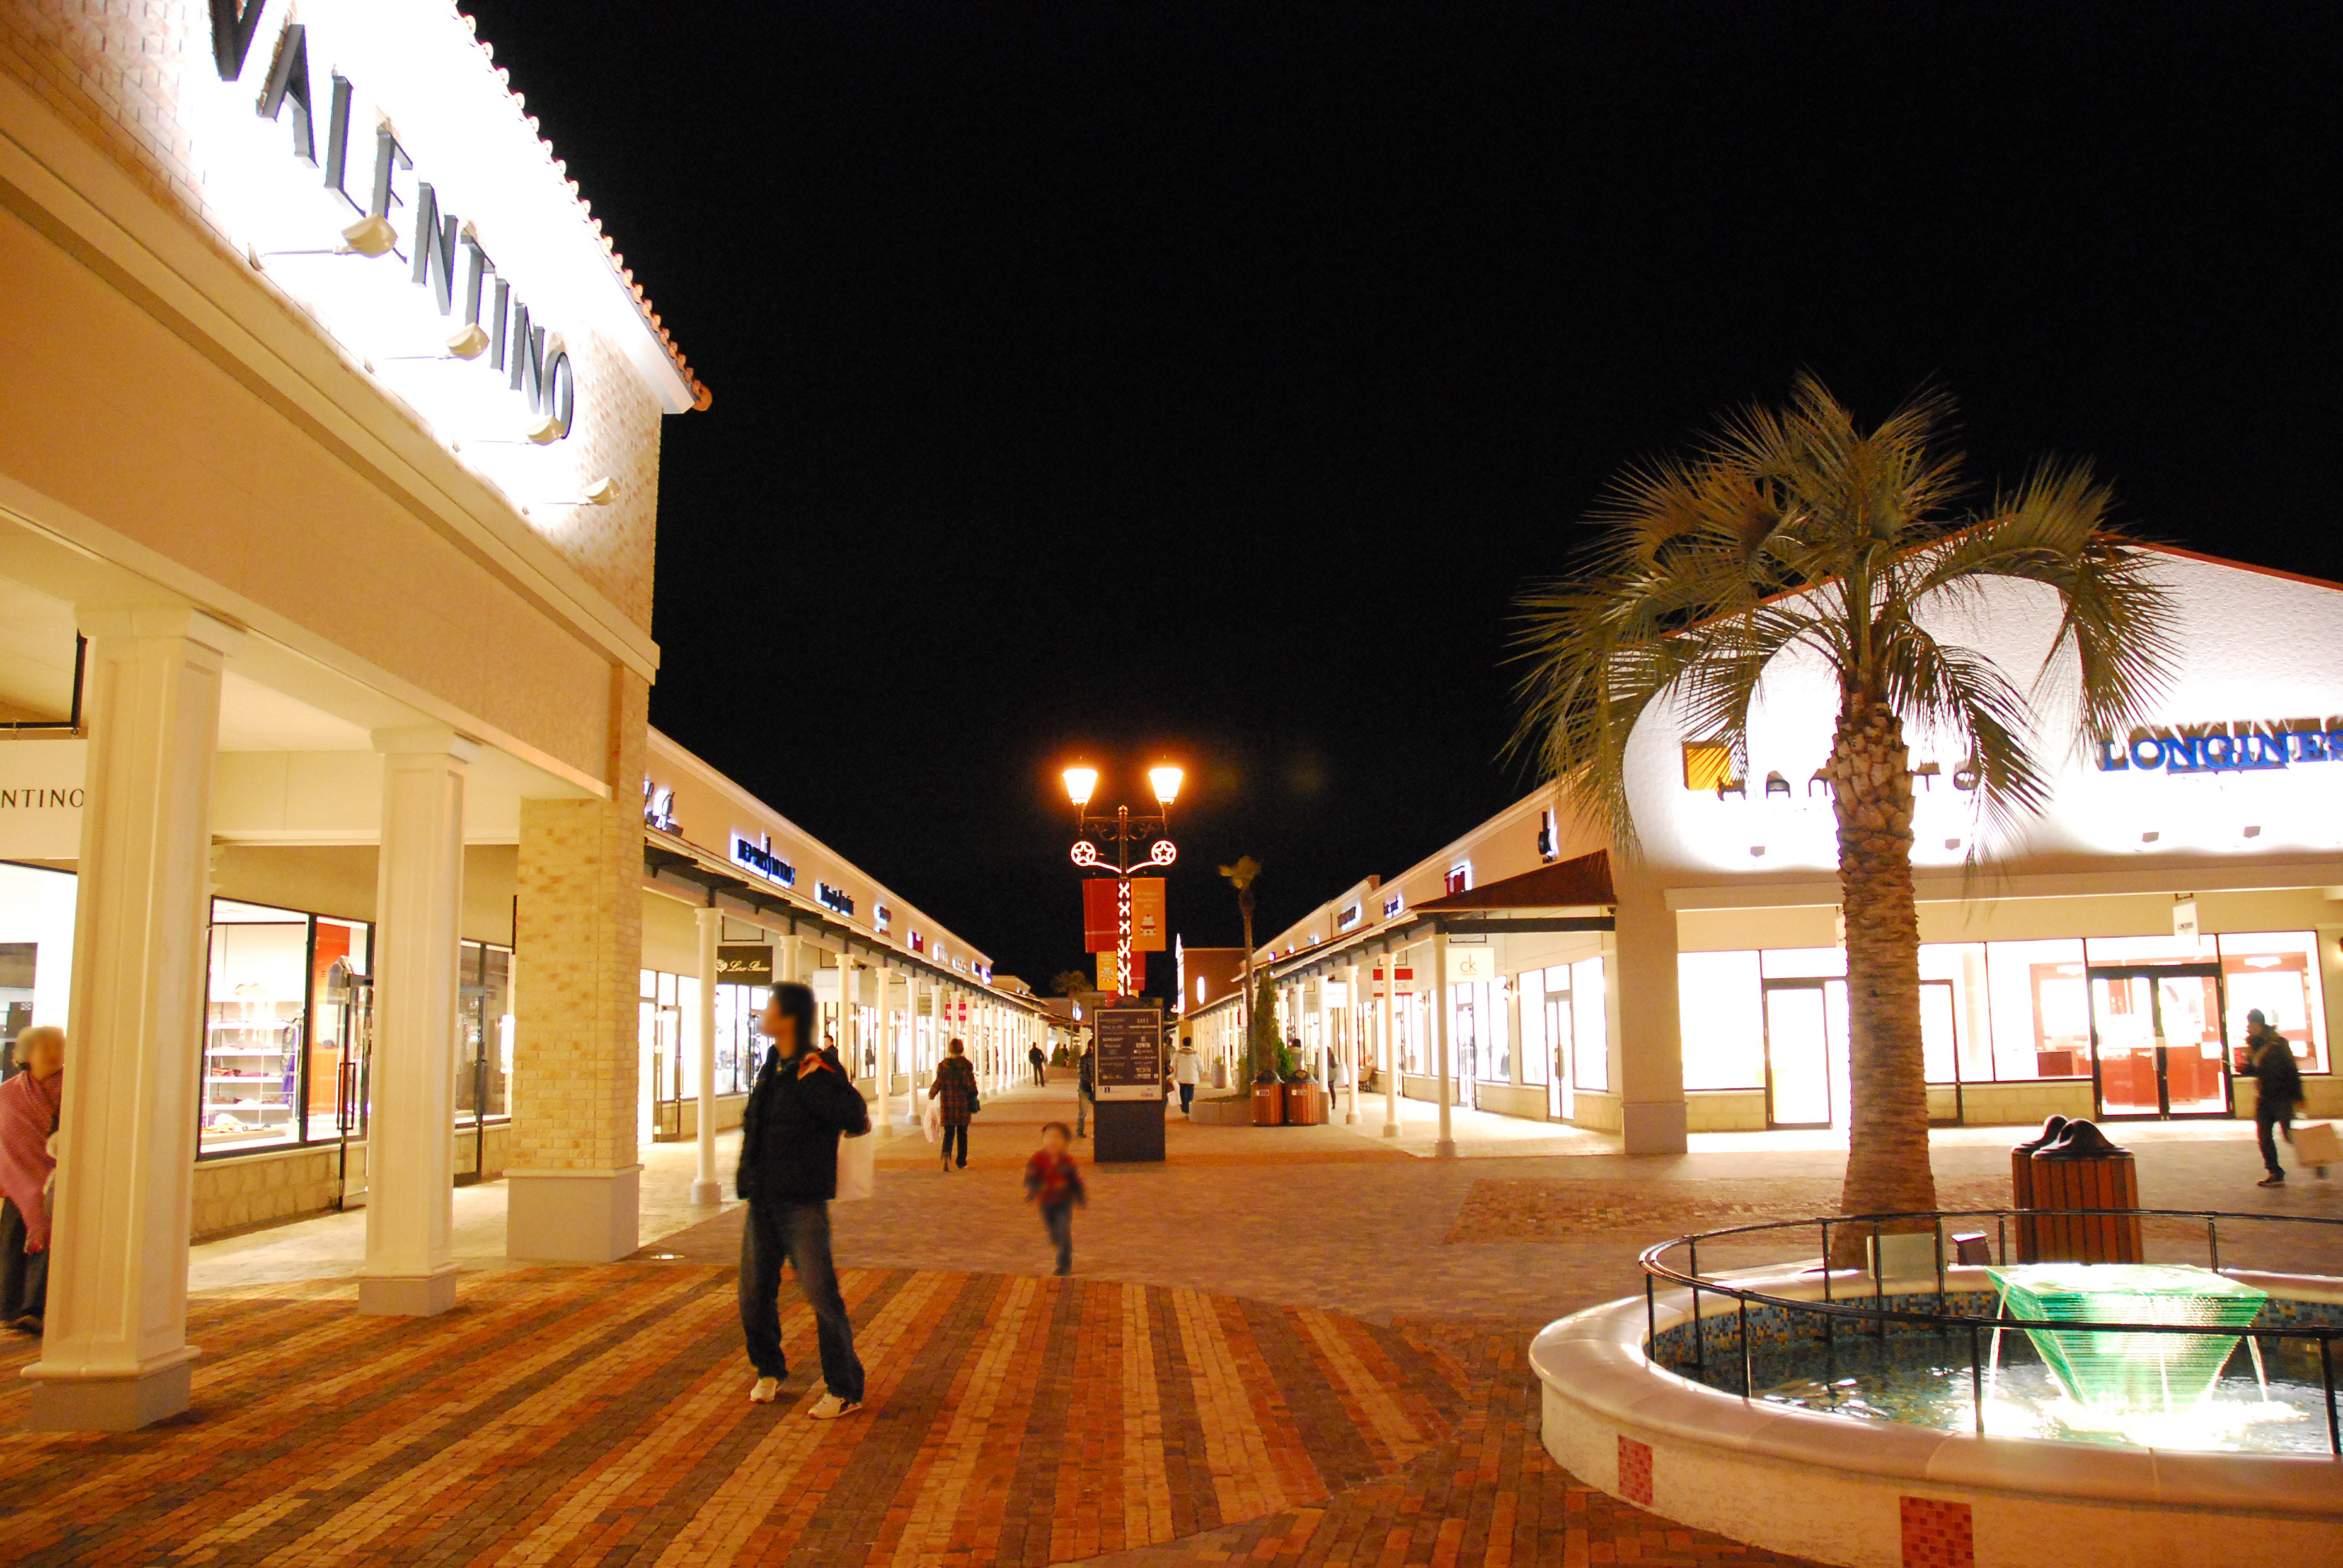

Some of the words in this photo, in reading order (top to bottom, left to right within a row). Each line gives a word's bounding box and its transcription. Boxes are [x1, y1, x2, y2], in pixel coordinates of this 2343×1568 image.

[209, 0, 574, 439] VALENTINO
[2, 789, 84, 808] NTINO
[1460, 953, 1476, 972] ck
